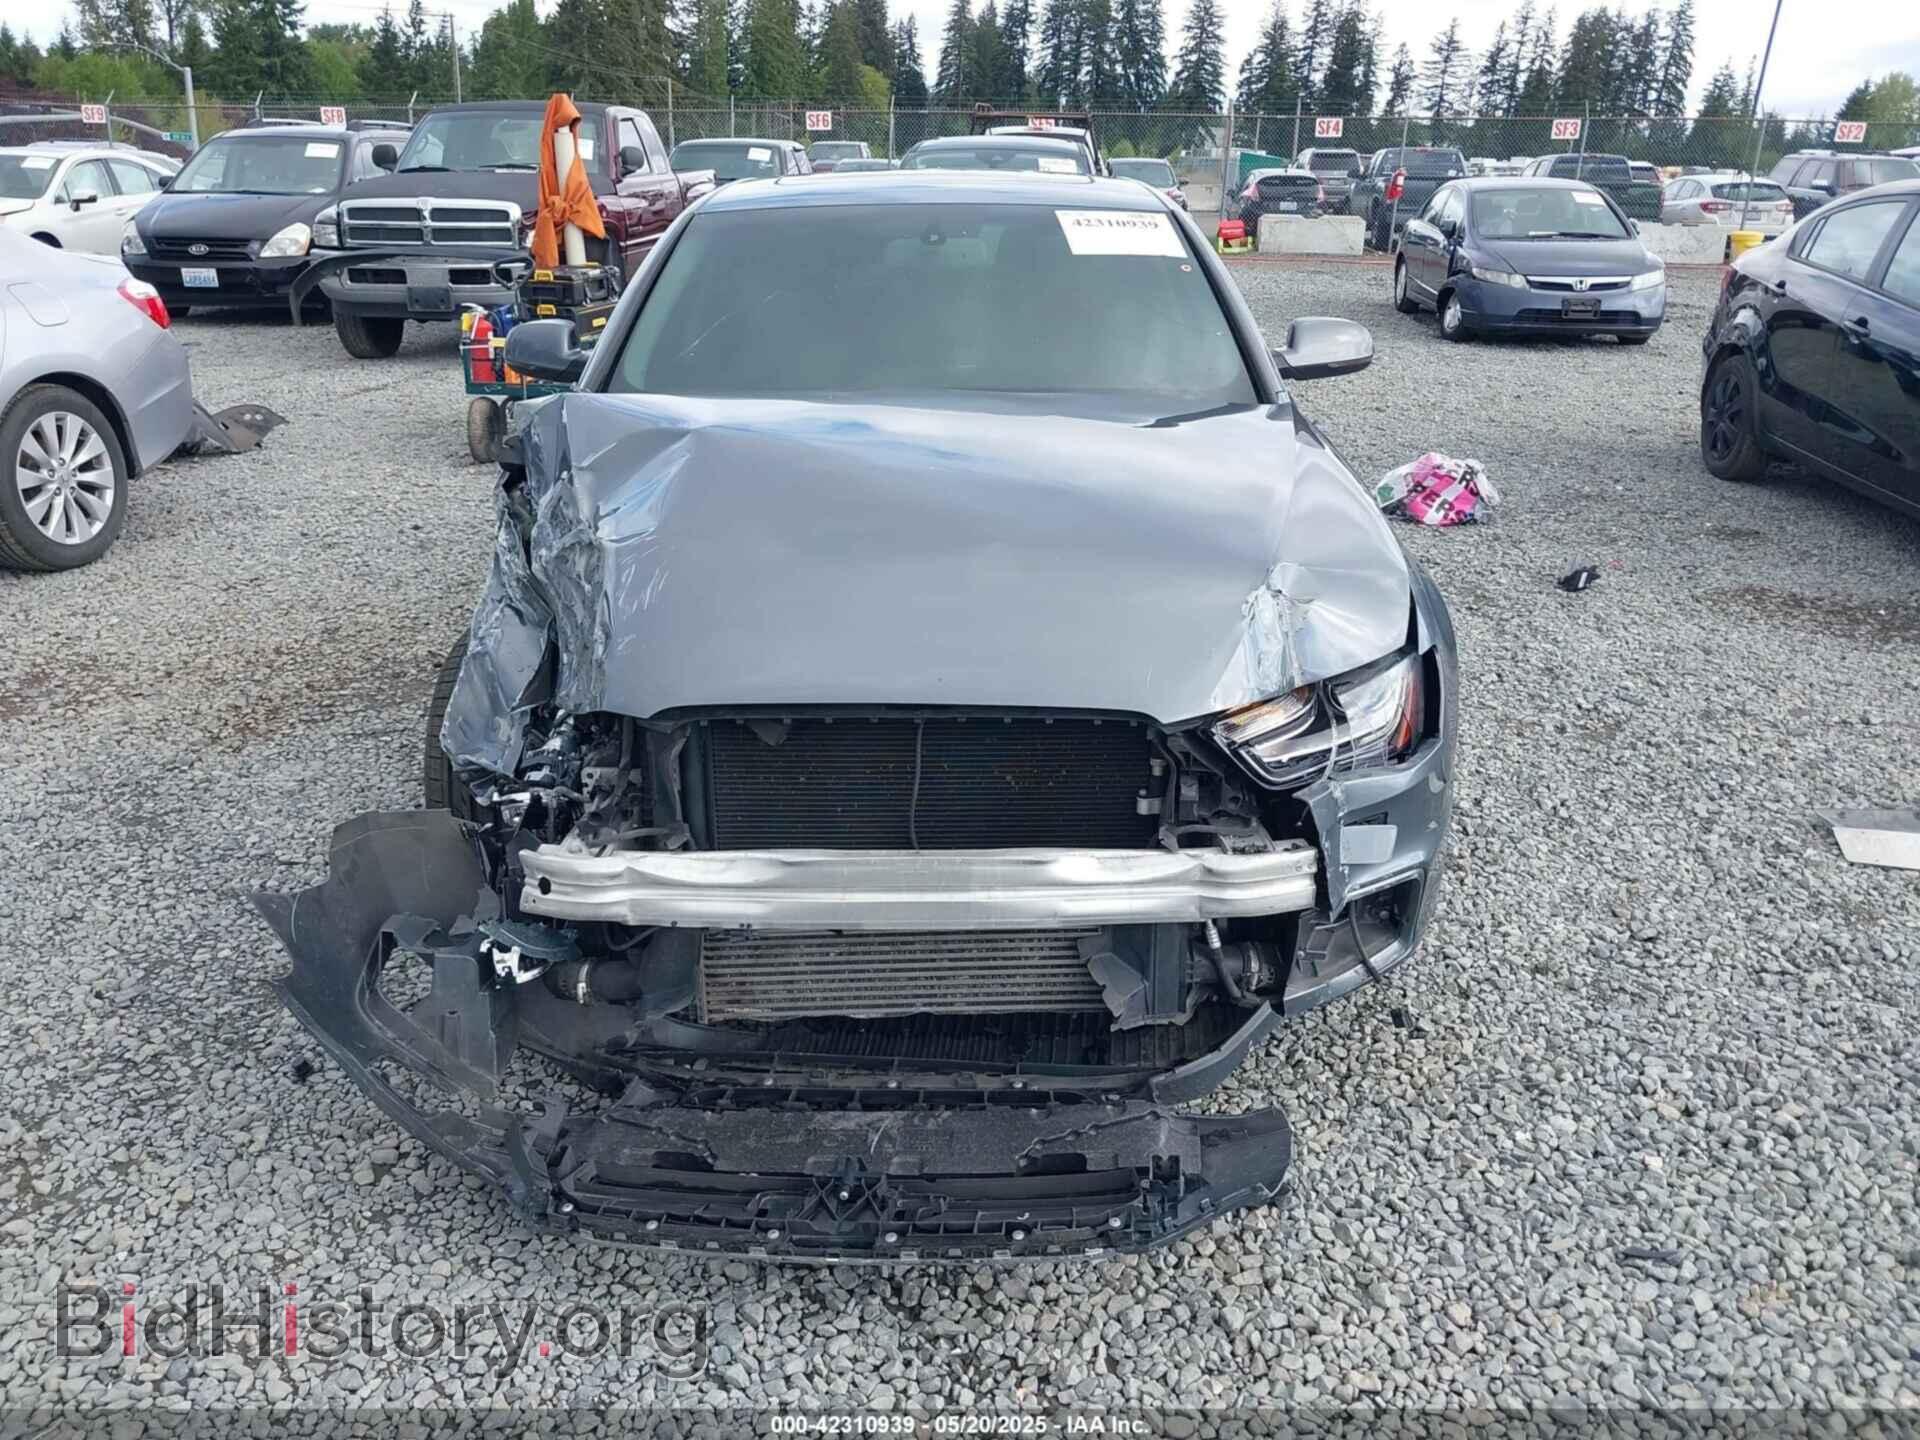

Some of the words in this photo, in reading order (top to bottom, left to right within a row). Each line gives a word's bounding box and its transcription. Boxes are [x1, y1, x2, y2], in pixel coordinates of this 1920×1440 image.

[84, 106, 104, 121] SF9
[808, 113, 830, 128] SF6
[1318, 120, 1341, 135] SF4
[1554, 121, 1579, 137] SF3
[1837, 124, 1864, 140] SF2
[1072, 217, 1159, 230] 42310939
